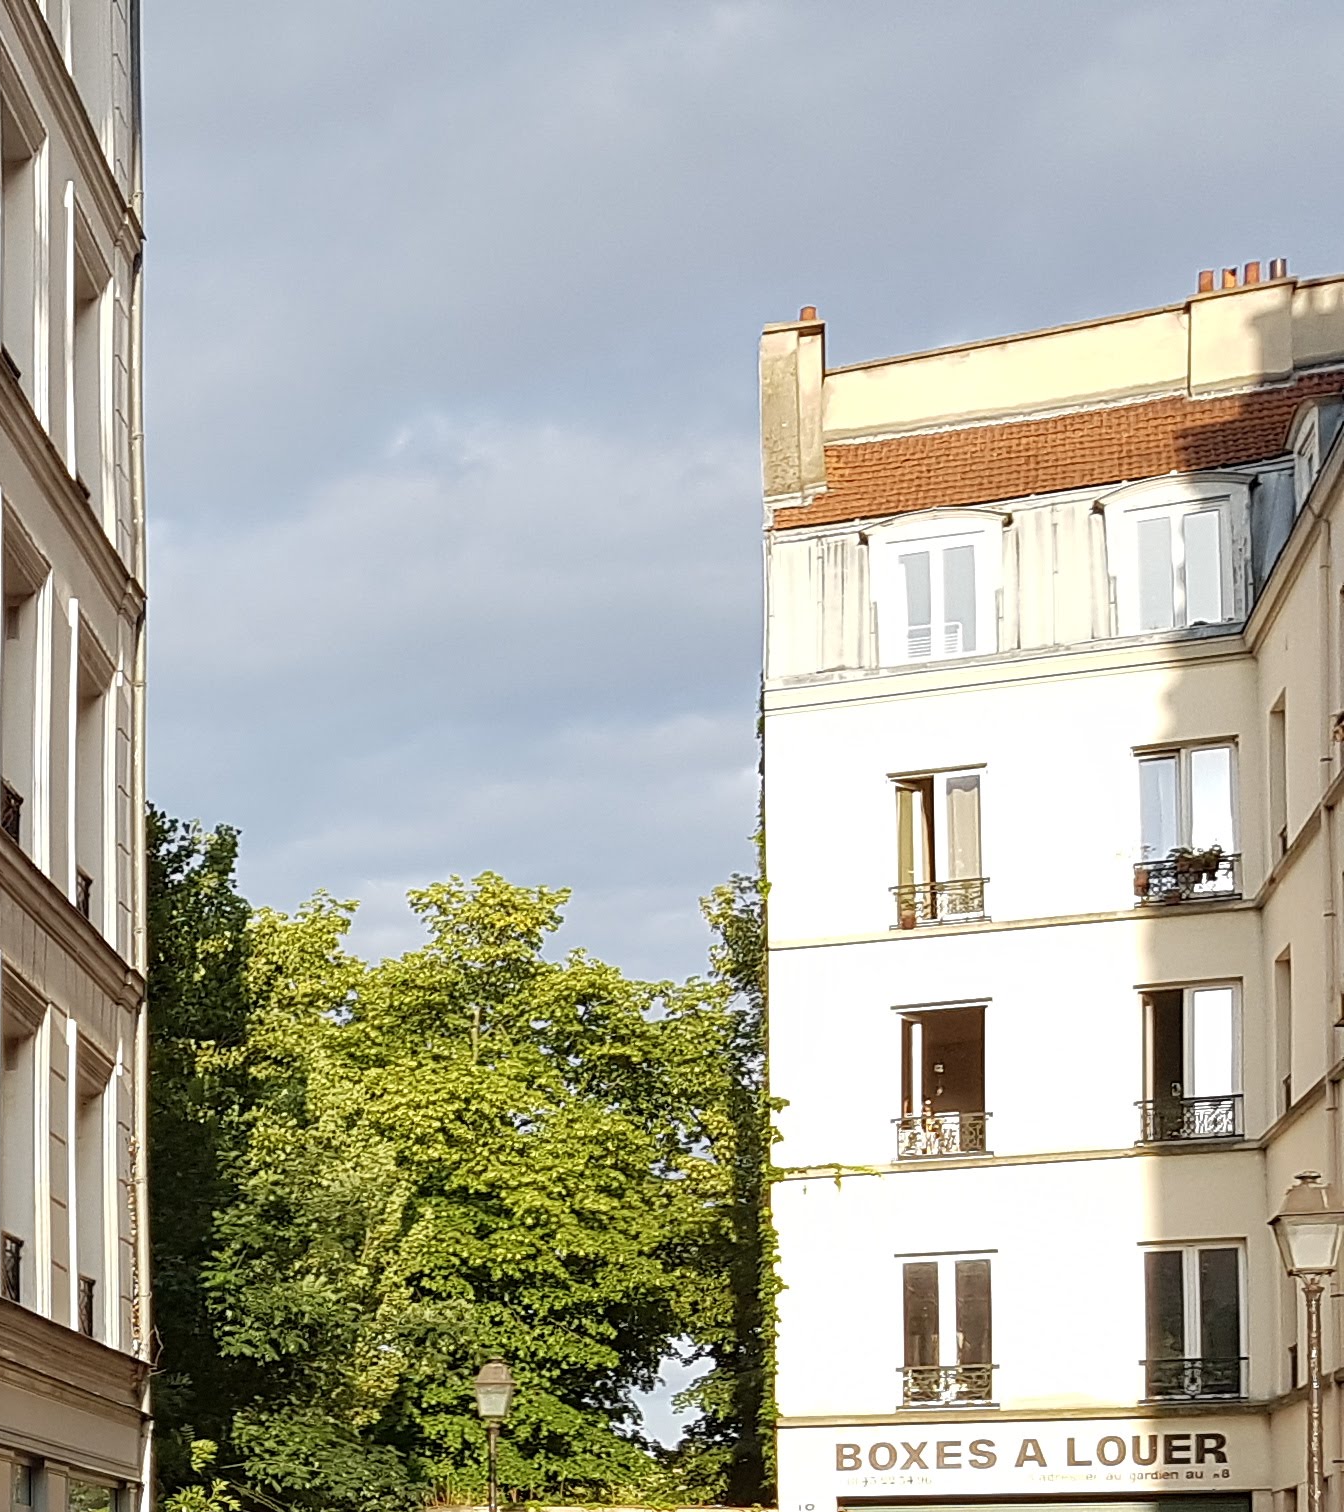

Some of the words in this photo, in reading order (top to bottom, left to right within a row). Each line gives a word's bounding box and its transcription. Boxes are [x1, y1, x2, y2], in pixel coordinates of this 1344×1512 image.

[835, 1438, 998, 1471] BOXES
[1014, 1438, 1048, 1467] A
[1066, 1432, 1229, 1467] LOUER
[1129, 1469, 1180, 1484] gardien
[1185, 1470, 1205, 1480] au
[798, 1503, 816, 1512] 10
